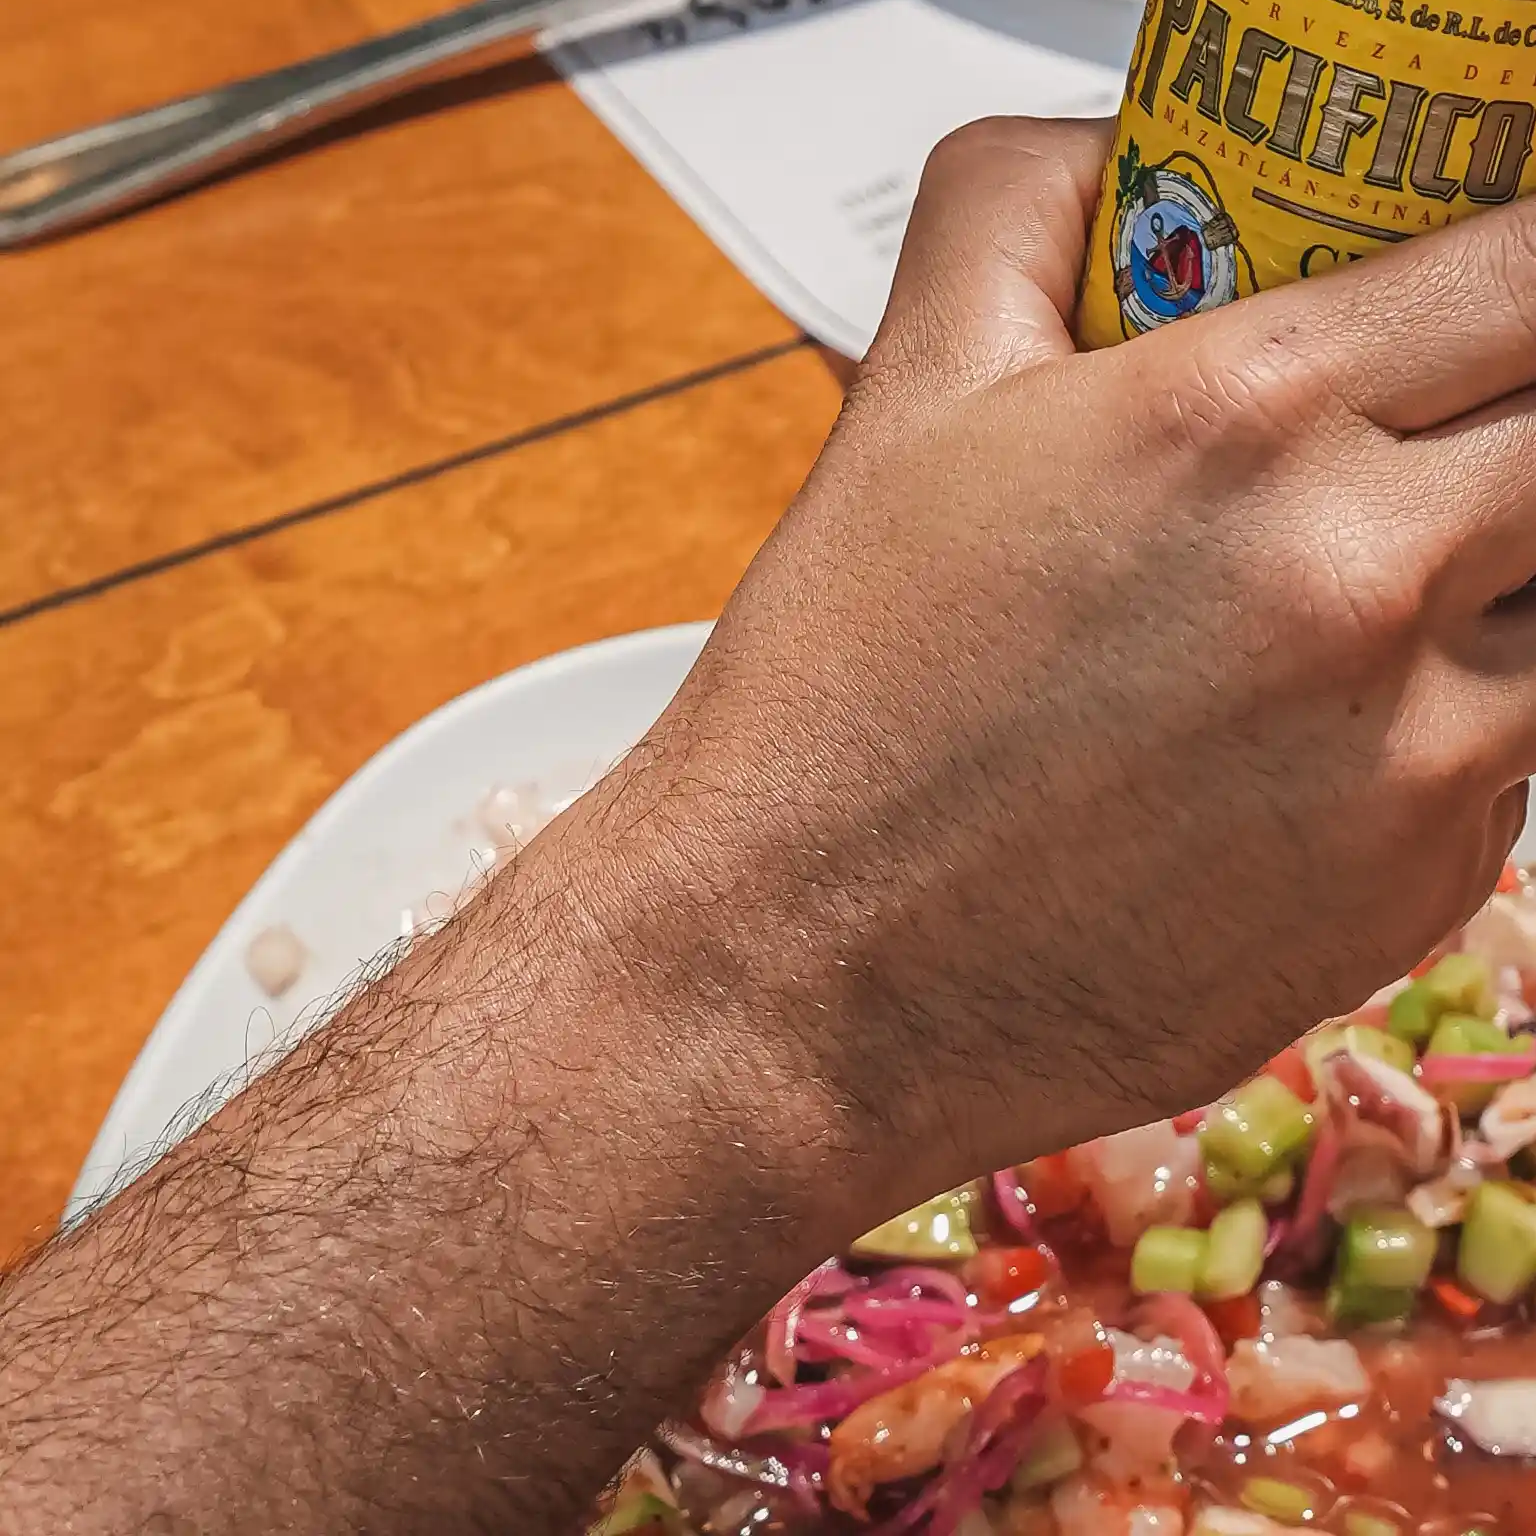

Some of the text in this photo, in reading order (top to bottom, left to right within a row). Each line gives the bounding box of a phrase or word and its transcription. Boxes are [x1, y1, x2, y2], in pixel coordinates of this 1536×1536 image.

[1410, 3, 1441, 32] de
[1441, 10, 1491, 42] R.L.
[1494, 21, 1522, 46] de
[1347, 193, 1452, 226] SINA
